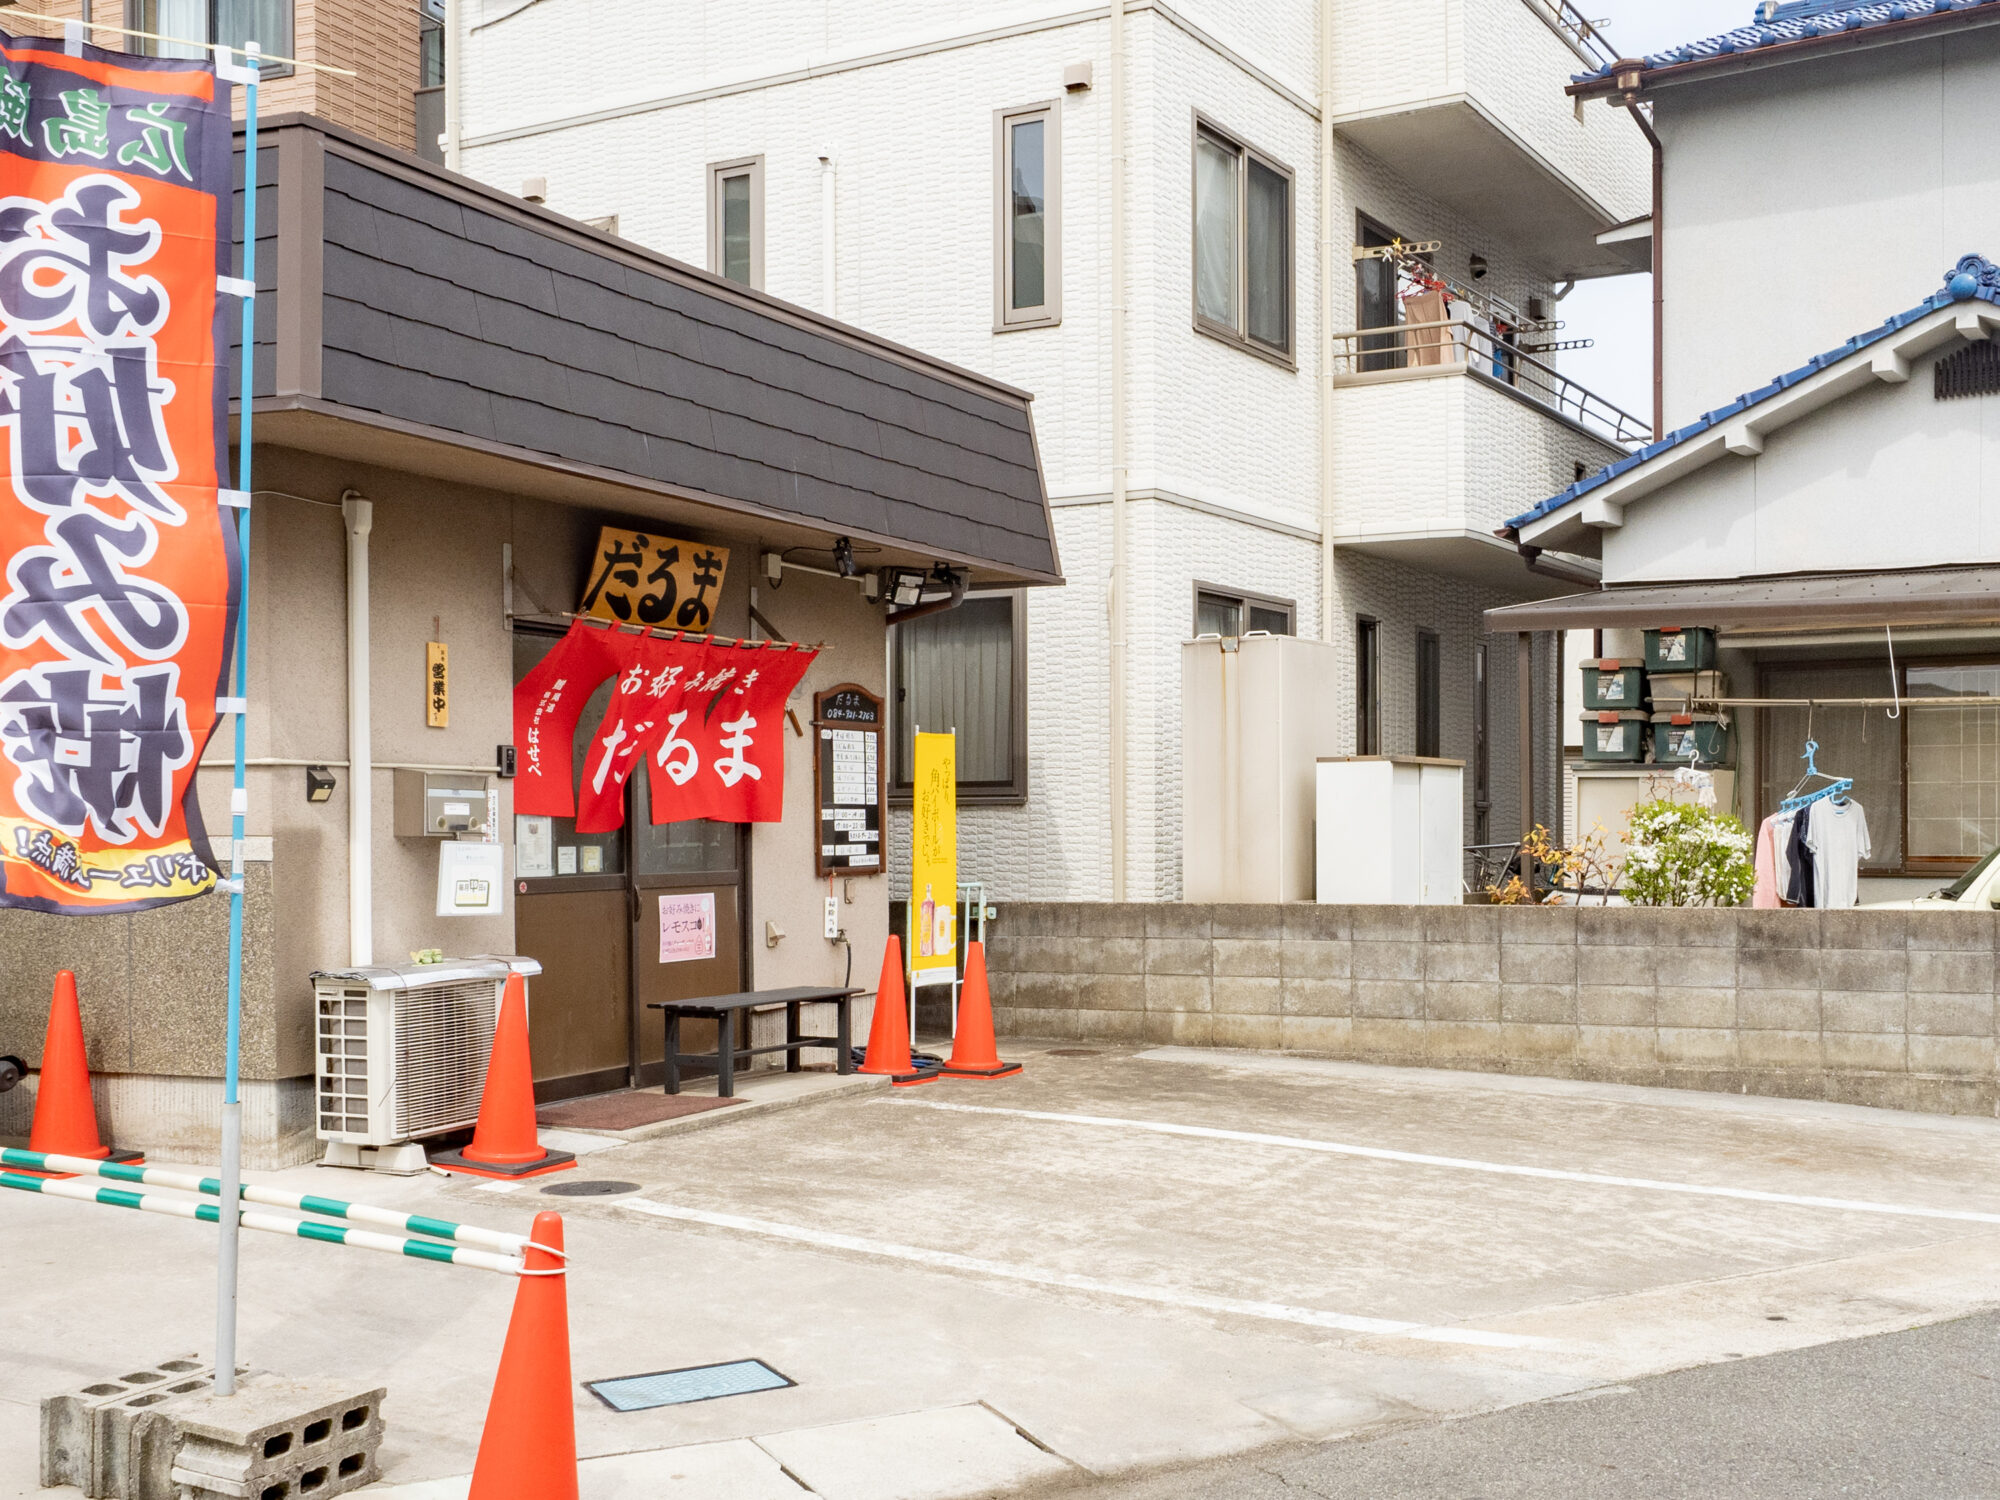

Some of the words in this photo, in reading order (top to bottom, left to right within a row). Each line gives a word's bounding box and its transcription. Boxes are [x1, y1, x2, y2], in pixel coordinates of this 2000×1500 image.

[583, 534, 722, 627] だるま
[432, 663, 446, 713] 営業中
[621, 664, 759, 699] お好み焼き
[593, 709, 762, 796] だるま
[662, 902, 701, 916] お好み焼きに
